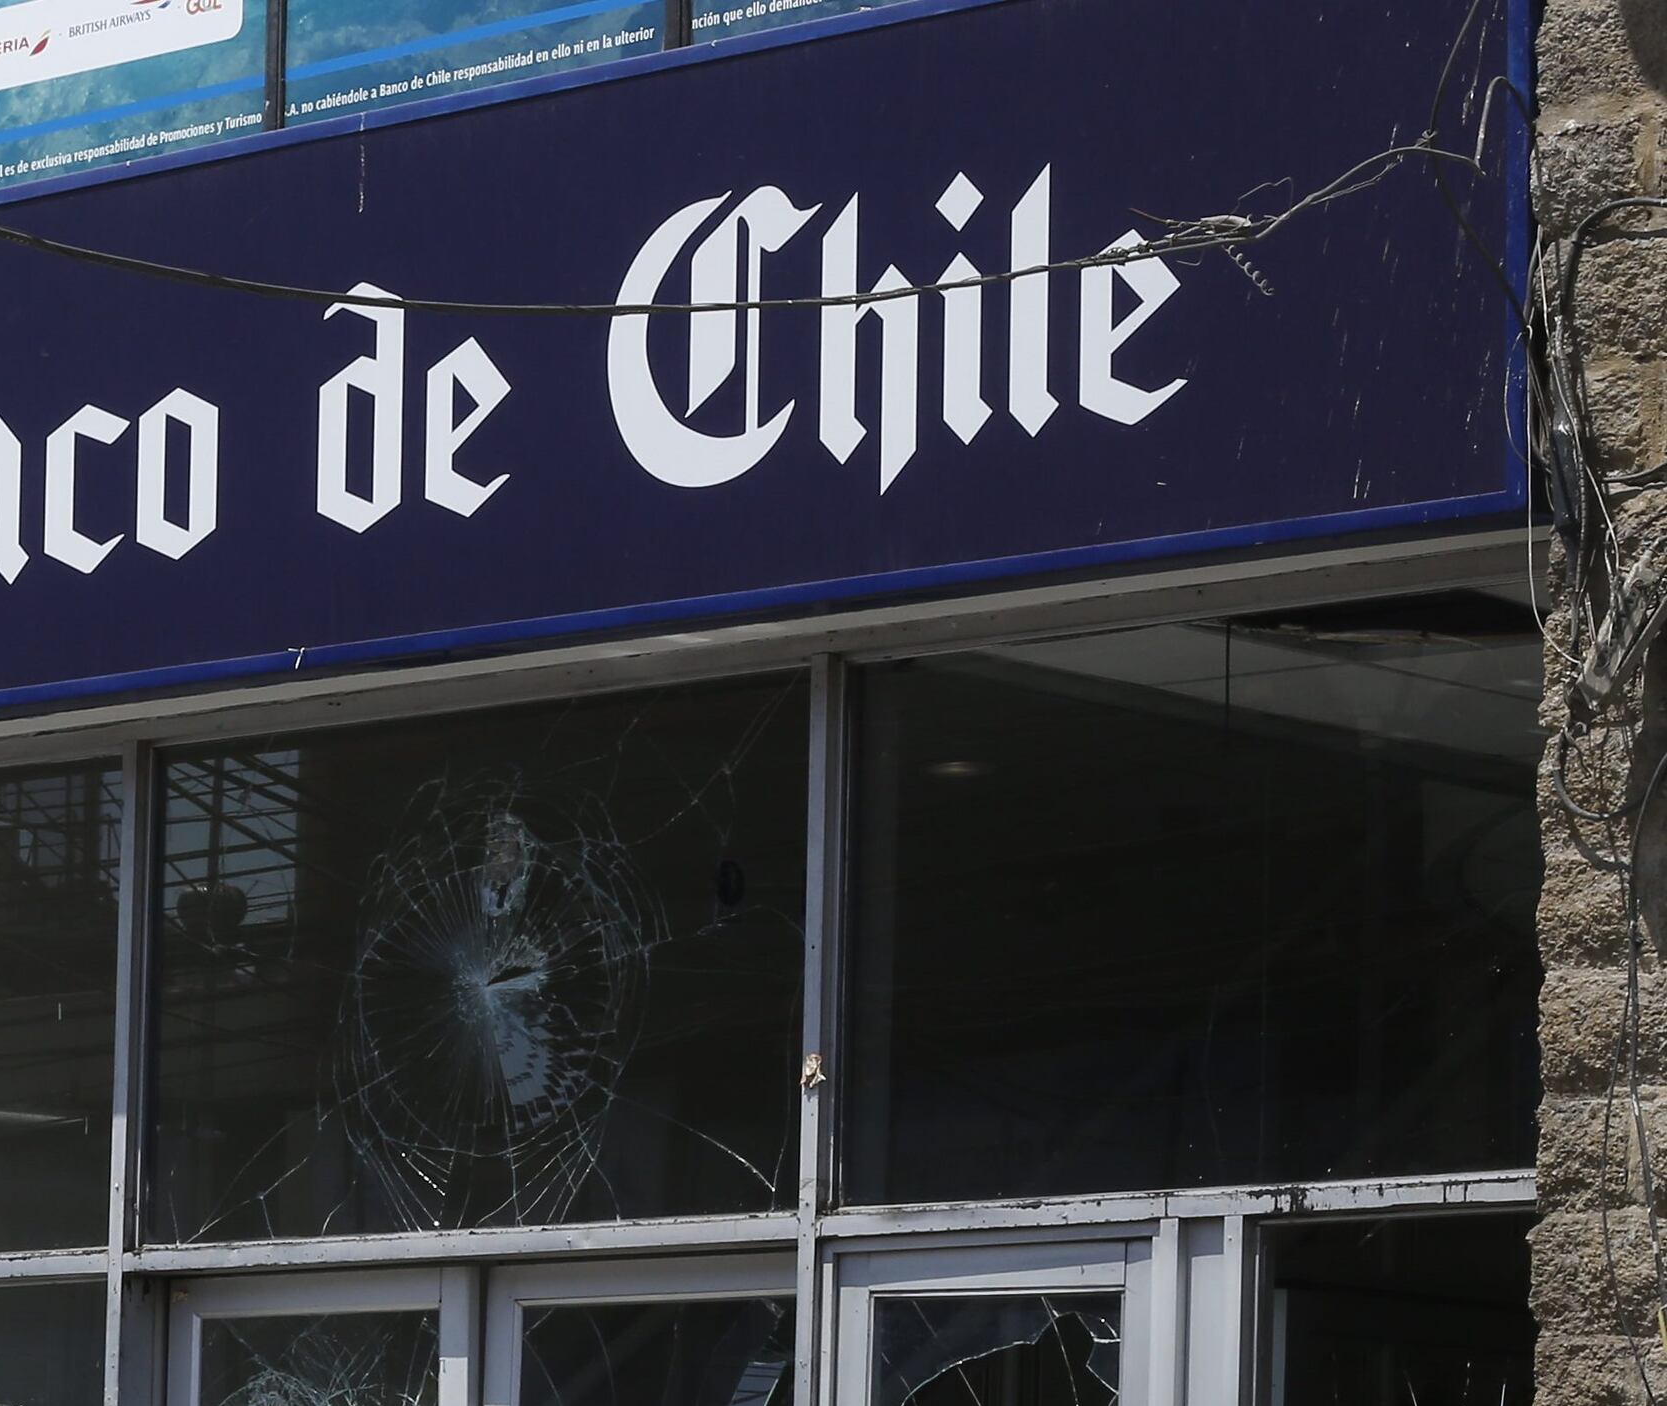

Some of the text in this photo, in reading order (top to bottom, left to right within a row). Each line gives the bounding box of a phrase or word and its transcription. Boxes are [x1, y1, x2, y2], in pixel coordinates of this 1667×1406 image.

[68, 19, 108, 39] BRITISH
[108, 9, 152, 29] AIRWAYS
[722, 10, 744, 26] que
[746, 3, 767, 18] ello
[301, 101, 314, 114] no
[316, 87, 369, 111] cabiéndole
[371, 88, 378, 99] a
[379, 78, 408, 98] Banco
[410, 74, 424, 89] de
[426, 67, 451, 88] Chile
[453, 50, 534, 83] responsabilidad
[536, 49, 549, 63] en
[551, 42, 571, 60] ello
[573, 39, 584, 55] ni
[586, 38, 600, 53] en
[602, 33, 613, 49] la
[614, 26, 655, 48] ulterior
[5, 164, 15, 177] es
[17, 160, 29, 175] de
[31, 149, 72, 172] exclusiva
[74, 136, 145, 163] responsabilidad
[147, 131, 158, 147] de
[159, 119, 215, 145] Promociones
[216, 120, 224, 135] y
[225, 112, 263, 130] Turismo
[317, 282, 512, 534] de
[607, 163, 1188, 496] Chile
